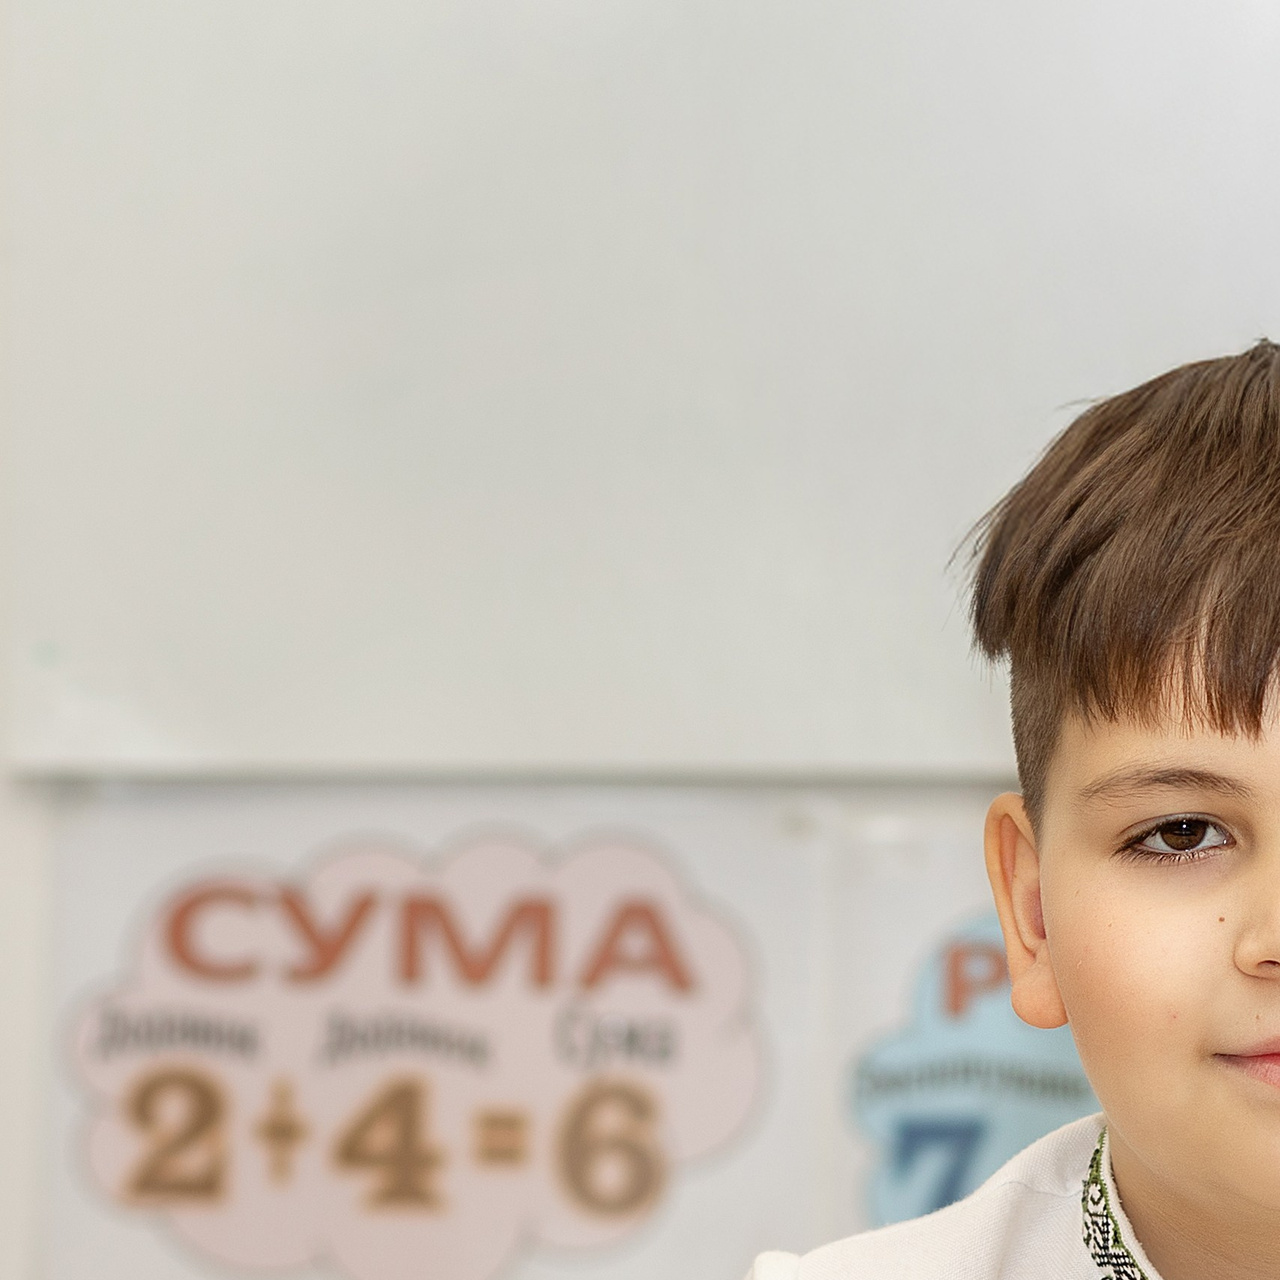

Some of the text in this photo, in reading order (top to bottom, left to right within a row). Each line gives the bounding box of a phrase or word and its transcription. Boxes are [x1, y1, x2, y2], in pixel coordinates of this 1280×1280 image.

[162, 882, 694, 992] СУМА
[124, 1068, 228, 1202] 2
[332, 1080, 446, 1212] 4
[556, 1082, 666, 1218] 6
